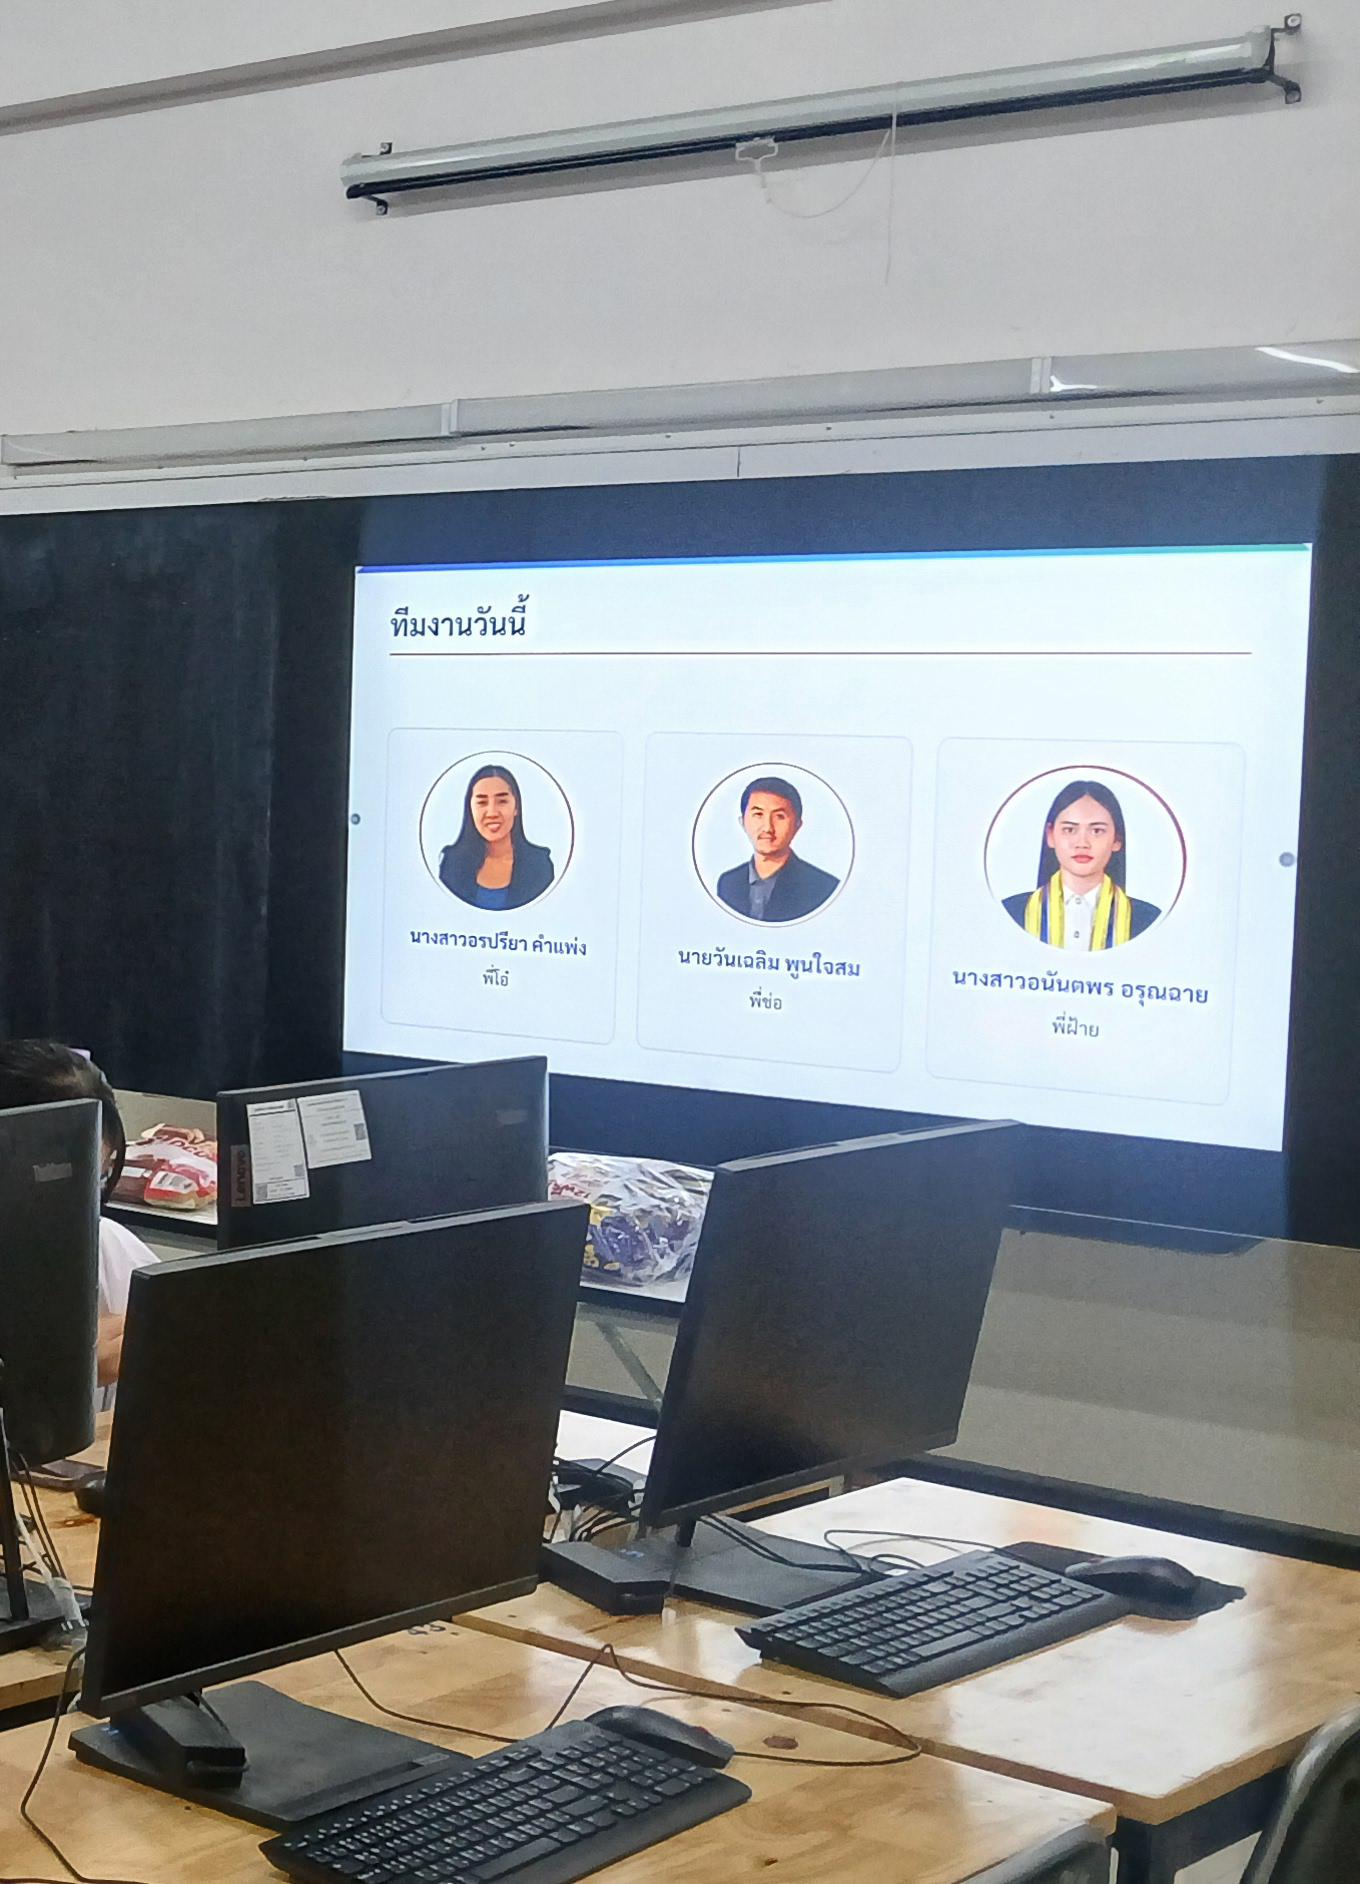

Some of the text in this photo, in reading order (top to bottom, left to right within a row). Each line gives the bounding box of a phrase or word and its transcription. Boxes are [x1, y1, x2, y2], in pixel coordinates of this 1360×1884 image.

[390, 593, 530, 637] ทีมงานวันนี้
[409, 930, 587, 956] นางสาวอรปรียา คำแพ่ง
[678, 946, 861, 979] นายวันเฉลิม พูนใจสม
[952, 970, 1209, 1007] นางสาวอนันตพร อรุณฉาย
